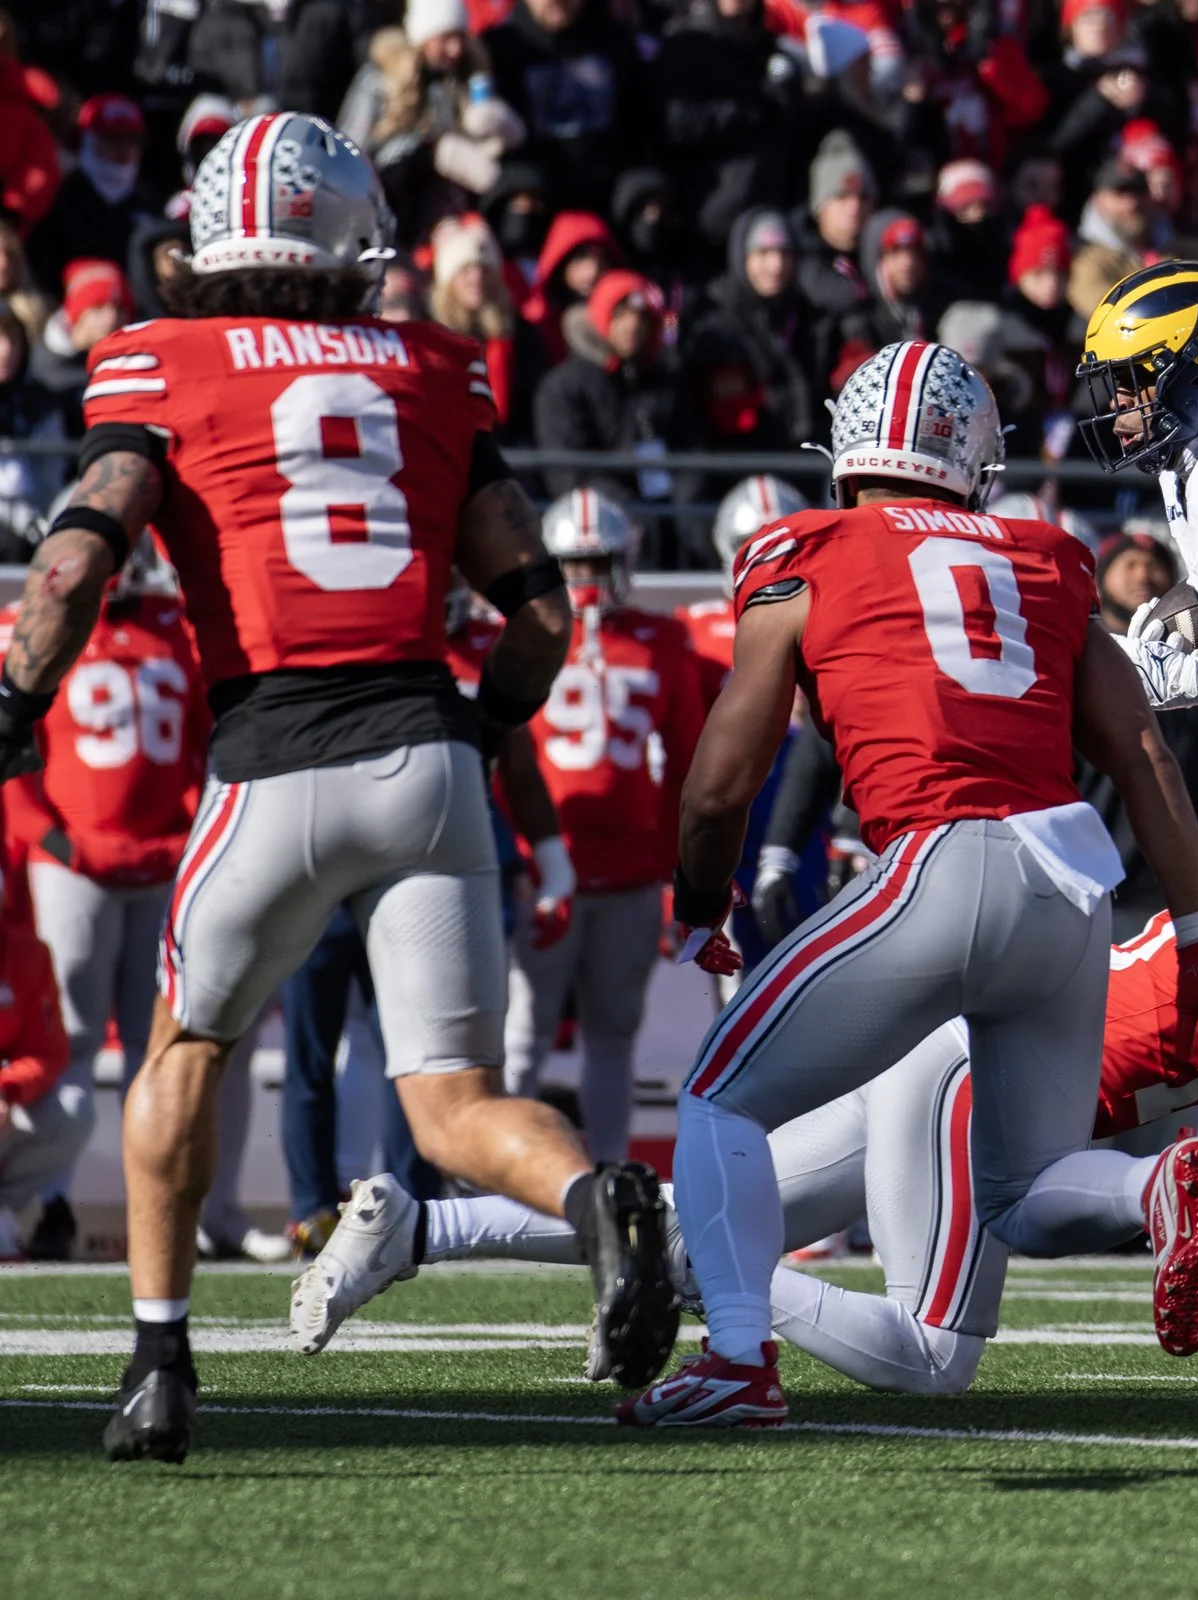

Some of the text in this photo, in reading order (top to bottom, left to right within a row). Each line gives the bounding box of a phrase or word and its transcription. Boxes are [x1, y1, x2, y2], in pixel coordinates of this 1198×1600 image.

[225, 324, 409, 370] RANSOM
[271, 372, 414, 591] 8
[847, 457, 948, 480] BUCKEYES
[883, 506, 1004, 540] SIMON
[907, 536, 1038, 699] 0
[67, 657, 188, 770] 96
[543, 665, 660, 770] 95
